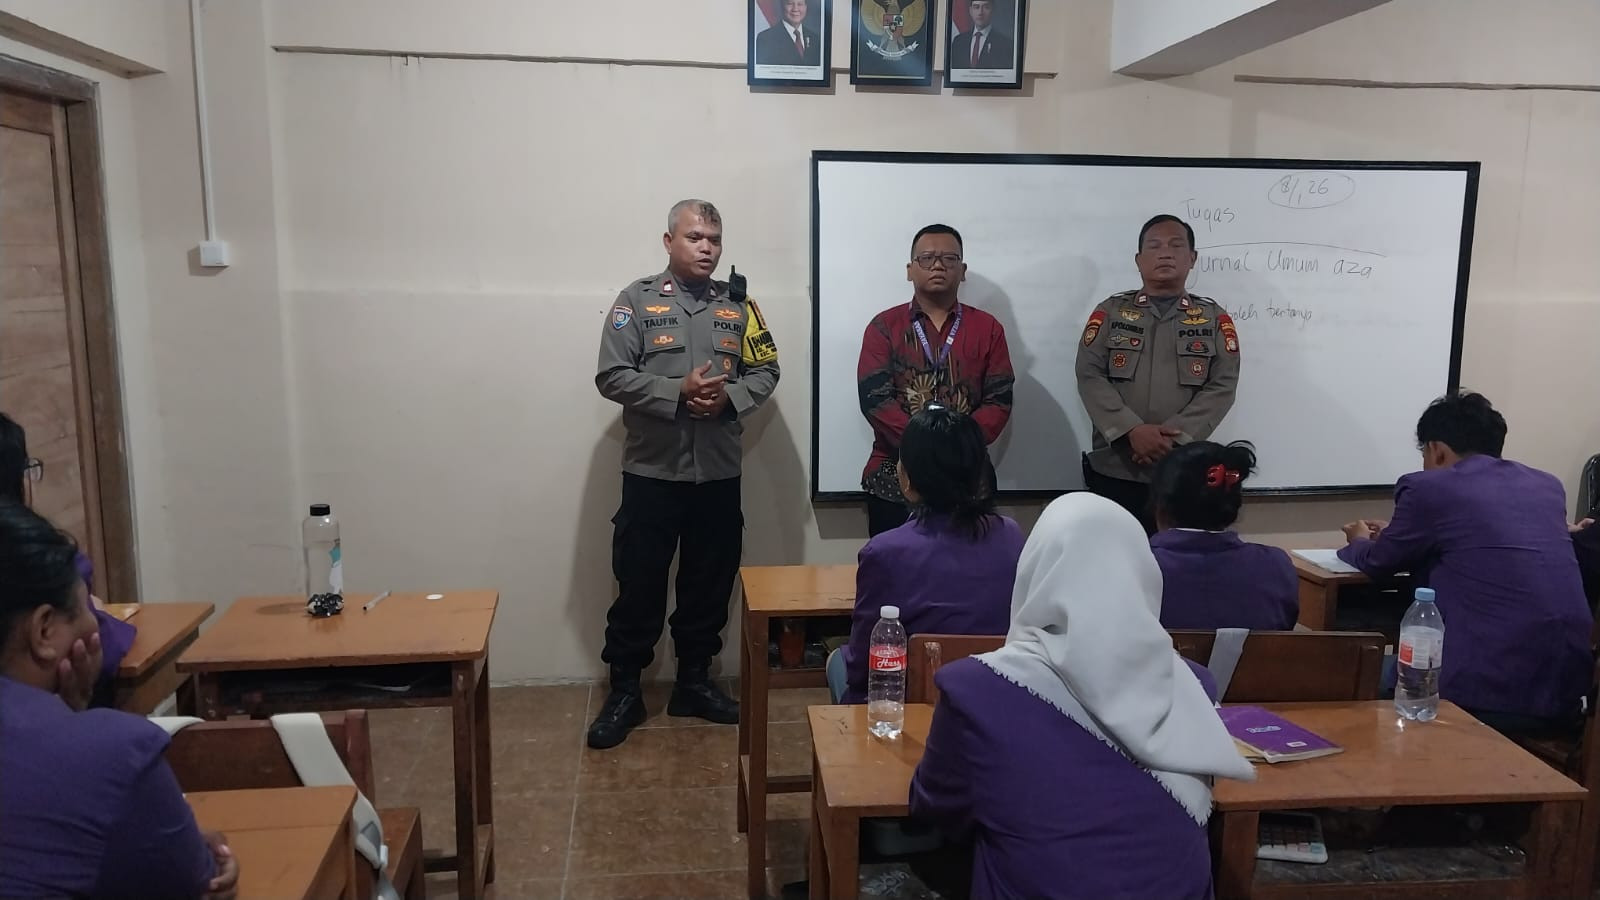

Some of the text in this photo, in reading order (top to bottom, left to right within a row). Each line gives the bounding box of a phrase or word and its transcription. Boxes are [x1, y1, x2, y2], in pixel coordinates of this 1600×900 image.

[1182, 198, 1236, 233] Tugas
[1267, 250, 1319, 273] Umum
[643, 315, 679, 329] TAUFIK
[713, 320, 742, 333] POLRI
[1178, 328, 1213, 338] POLRI
